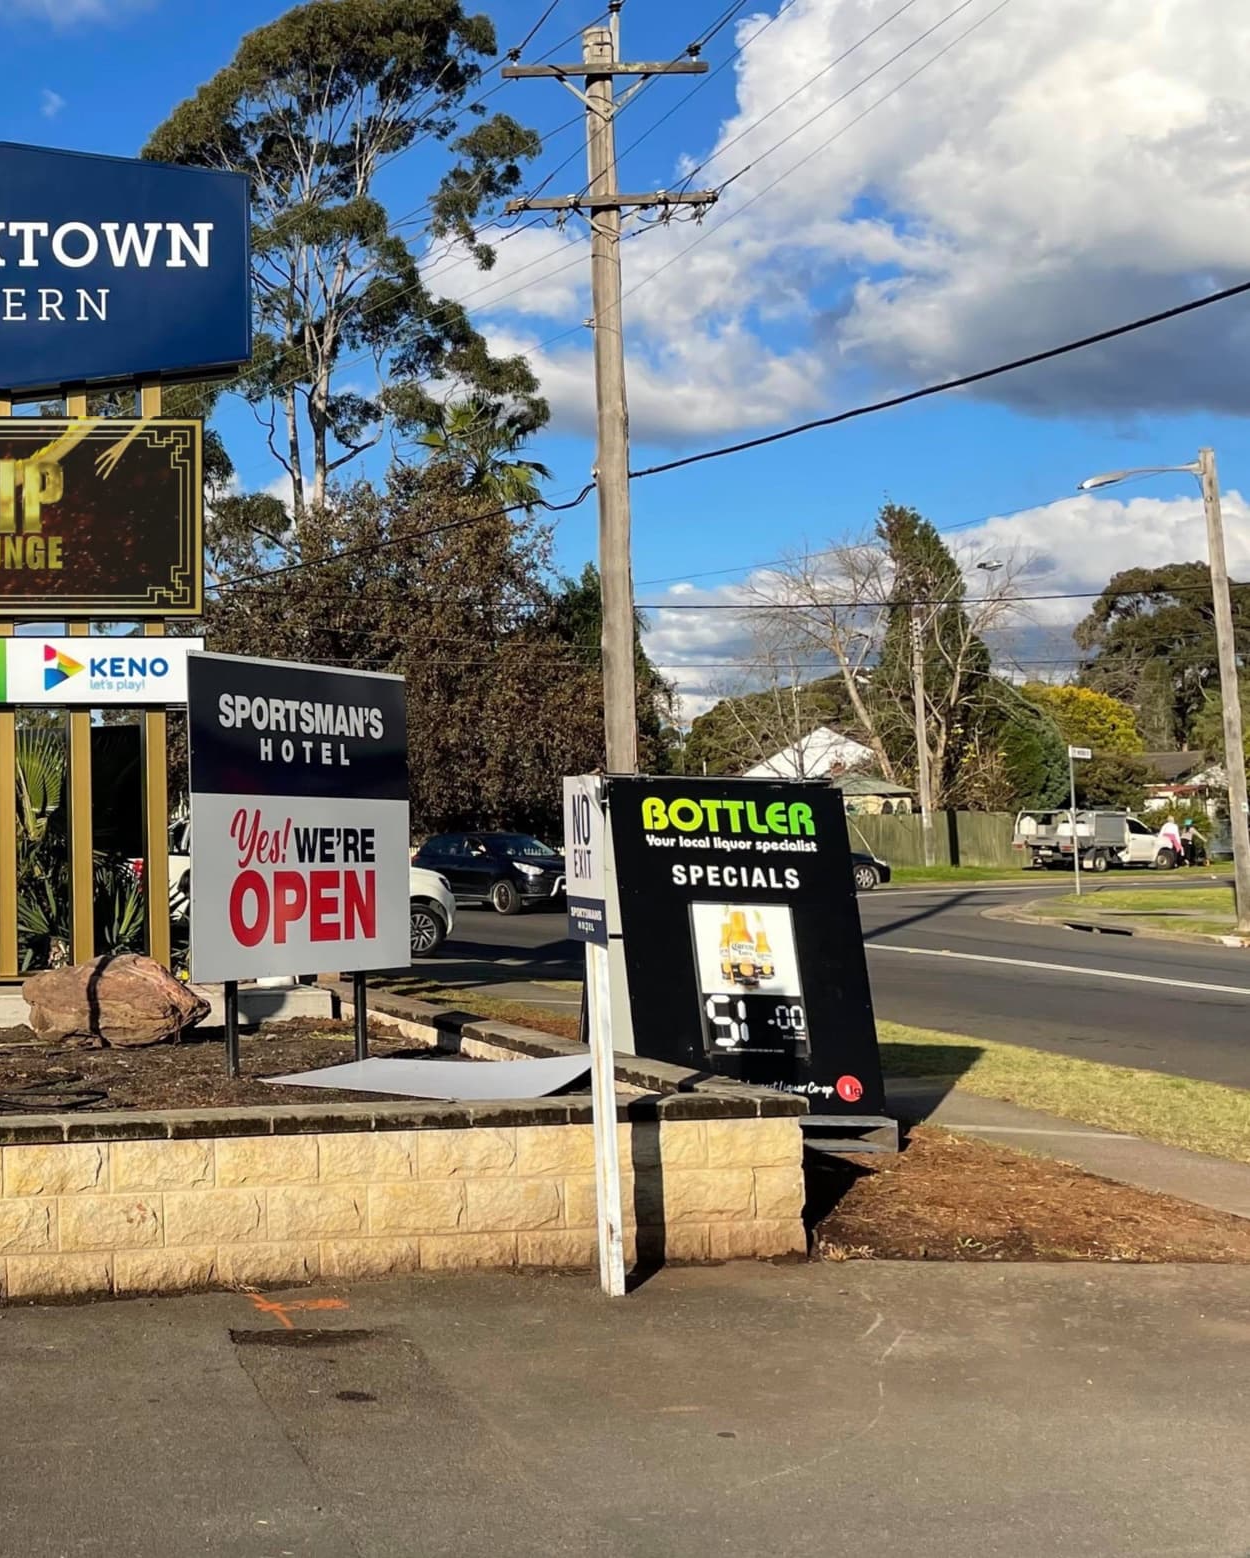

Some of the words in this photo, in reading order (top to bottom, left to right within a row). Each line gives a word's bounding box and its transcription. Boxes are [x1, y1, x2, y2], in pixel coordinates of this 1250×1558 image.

[90, 657, 169, 677] KENO
[90, 680, 114, 690] let's
[116, 679, 145, 692] play!
[219, 693, 383, 739] SPORTSMAN'S
[260, 738, 350, 766] HOTEL
[572, 794, 591, 846] NO
[642, 797, 816, 835] BOTTLER
[230, 808, 292, 868] Yes!
[294, 828, 375, 863] WE'RE
[646, 835, 676, 847] Your
[679, 835, 710, 848] local
[713, 837, 752, 852] liquor
[755, 840, 817, 853] specialist
[573, 850, 592, 880] EXIT
[672, 864, 800, 889] SPECIALS
[229, 869, 376, 947] OPEN
